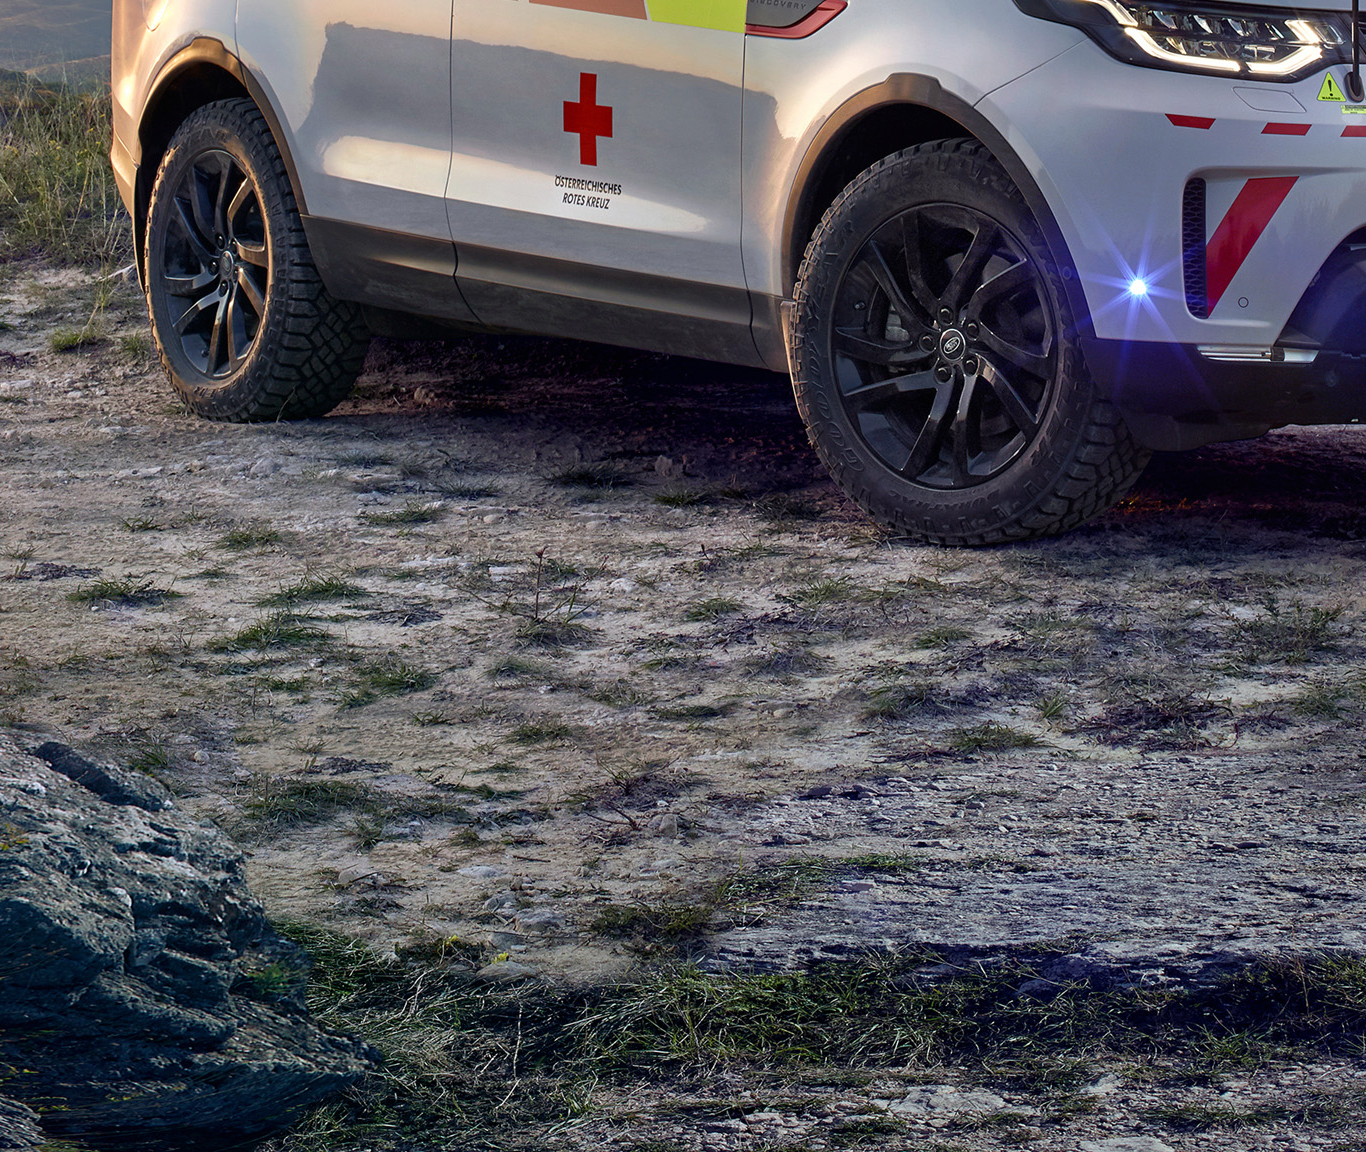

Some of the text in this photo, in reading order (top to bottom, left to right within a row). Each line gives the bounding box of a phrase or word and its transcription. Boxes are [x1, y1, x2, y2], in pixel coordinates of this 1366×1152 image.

[555, 175, 622, 195] ÖSTERREICHISCHES
[563, 193, 610, 209] ROTES KREUZ
